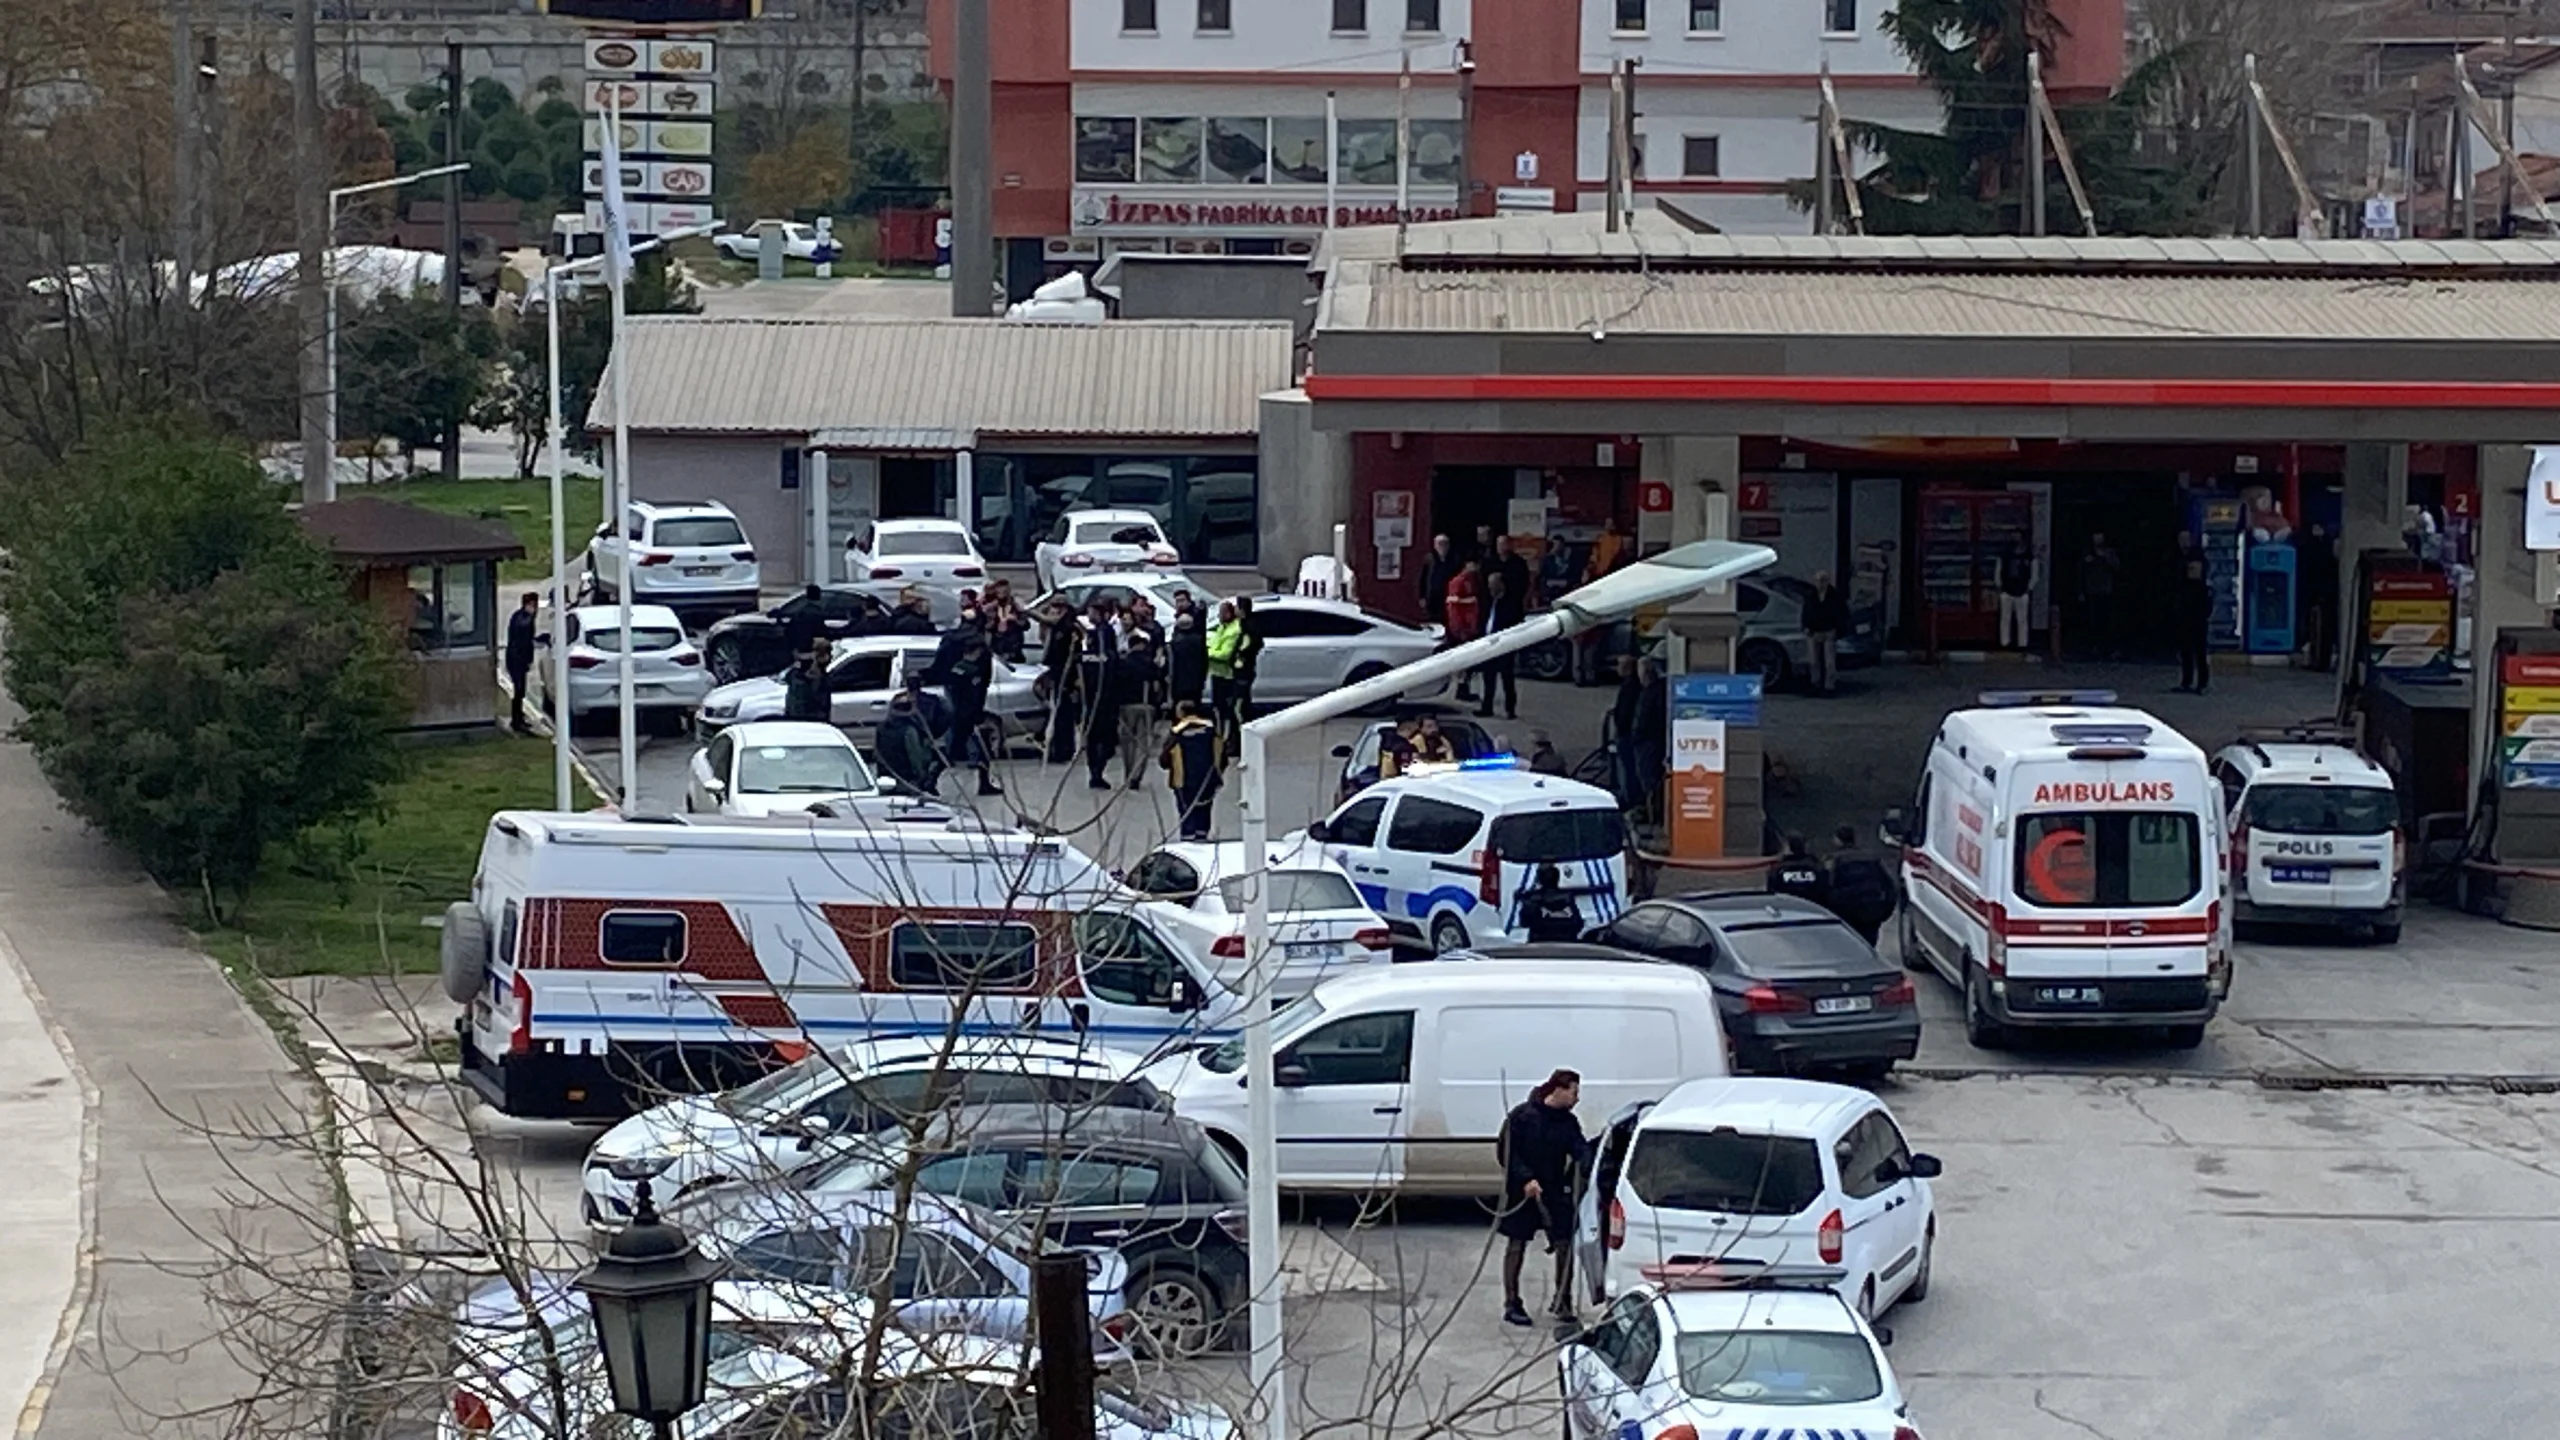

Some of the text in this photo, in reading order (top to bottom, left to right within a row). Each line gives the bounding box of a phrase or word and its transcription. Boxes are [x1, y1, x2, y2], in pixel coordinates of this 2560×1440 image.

[1290, 205, 1350, 227] SATŞ
[1648, 487, 1662, 506] 8
[1749, 486, 1761, 505] 7
[2455, 494, 2468, 512] 2
[1676, 738, 1720, 751] UTTS
[2034, 782, 2175, 803] AMBULANS
